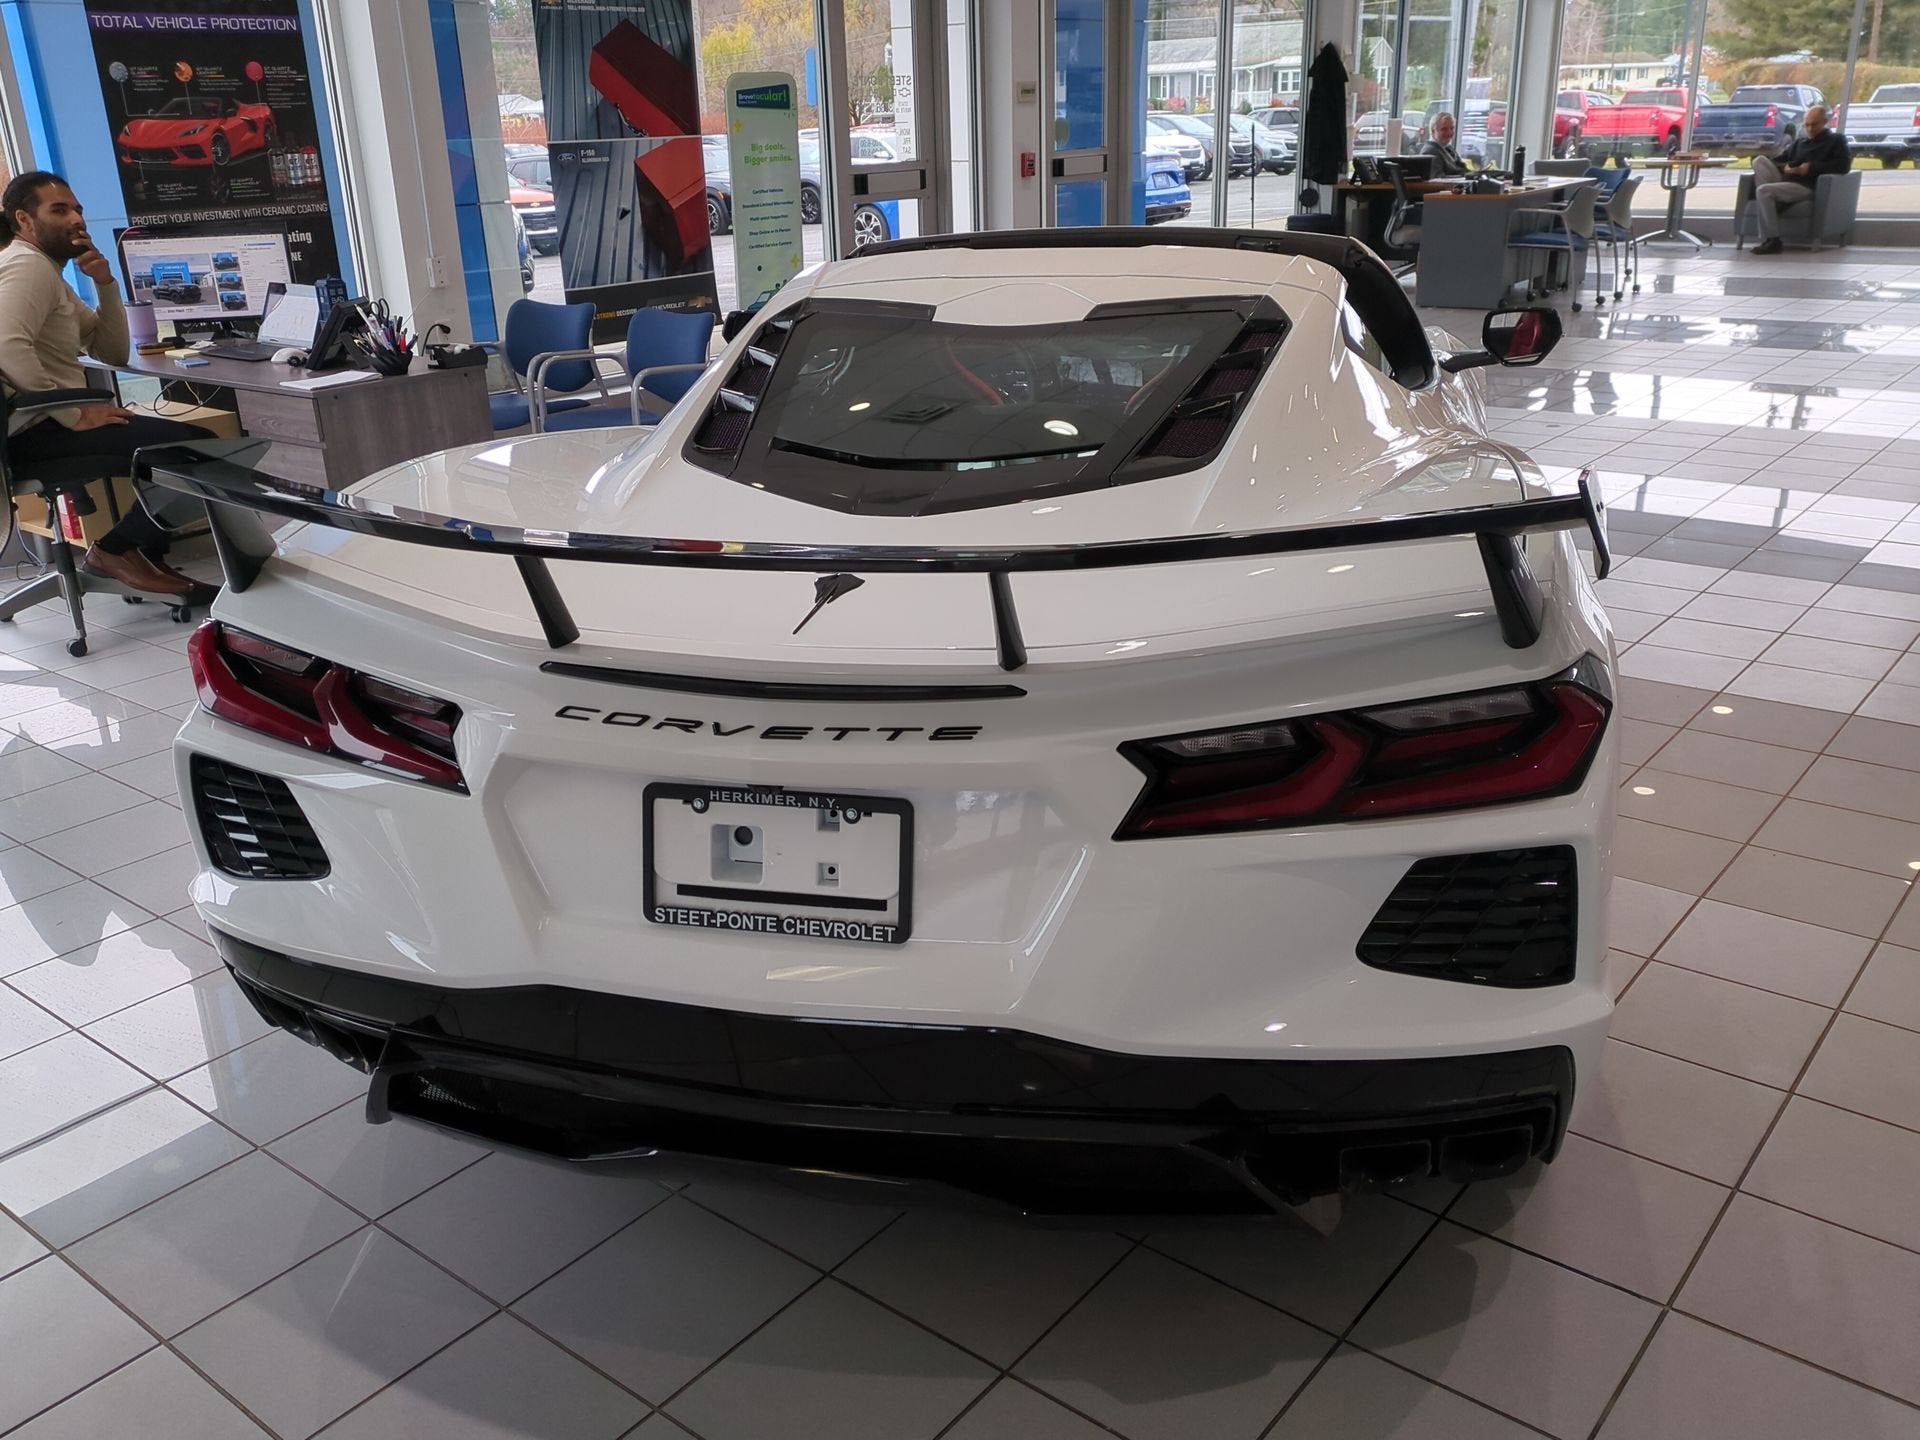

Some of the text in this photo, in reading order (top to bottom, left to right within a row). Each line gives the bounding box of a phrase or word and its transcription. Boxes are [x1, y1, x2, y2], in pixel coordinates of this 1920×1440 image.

[91, 15, 297, 31] TOTAL VEHICLE PROTECTION
[751, 143, 785, 153] Big deals.
[744, 154, 793, 166] Bigger smiles.
[131, 203, 328, 226] PROTECT YOUR INVESTMENT WITH CERAMIC COATING
[596, 311, 616, 320] STRONG
[616, 308, 638, 317] DECISION
[554, 705, 983, 742] CORVETTE
[709, 790, 840, 809] HERKIMER, N.Y.
[654, 907, 896, 943] STEET-PONTE CHEVROLET
